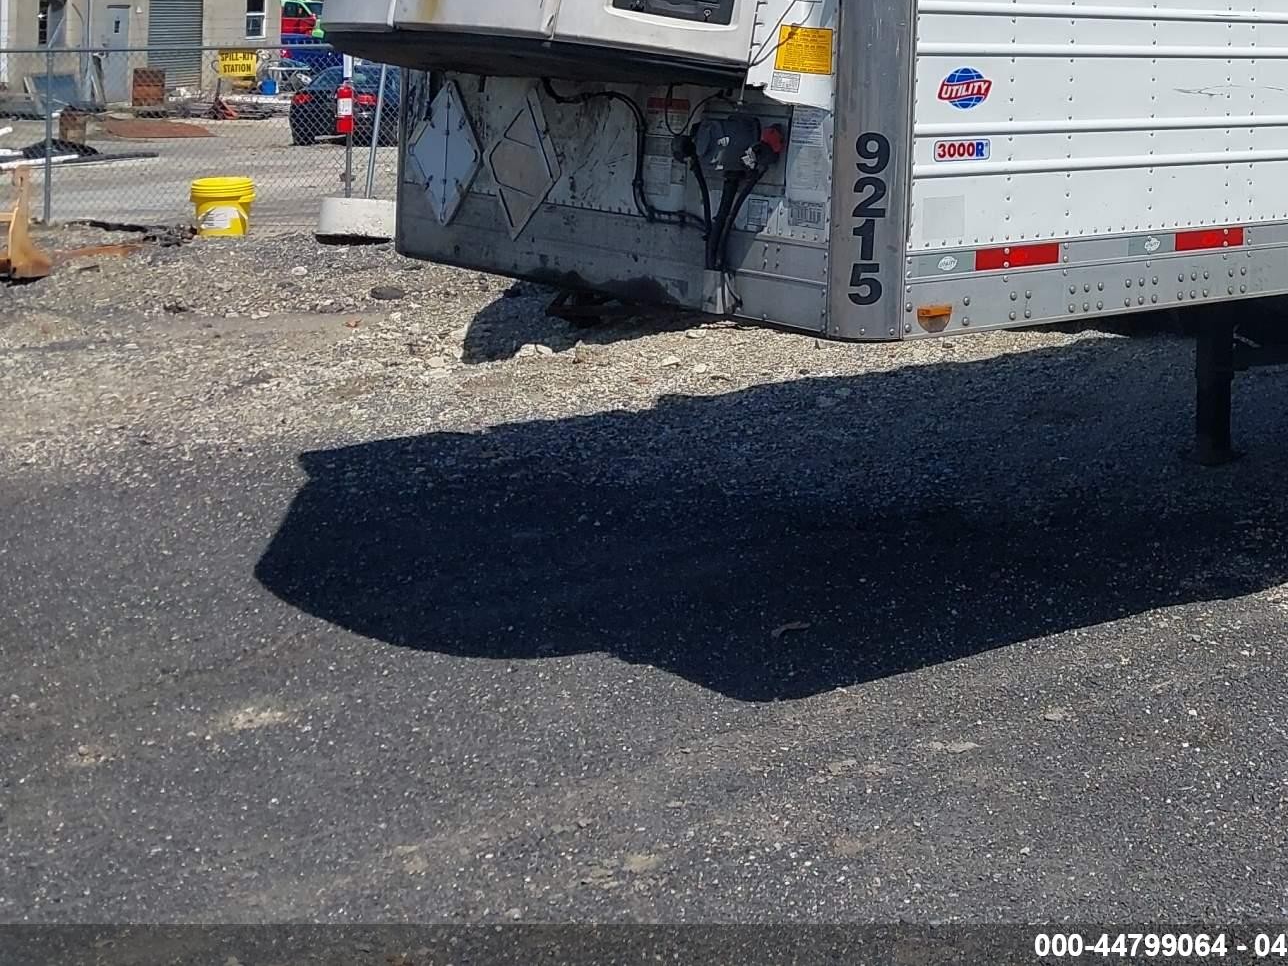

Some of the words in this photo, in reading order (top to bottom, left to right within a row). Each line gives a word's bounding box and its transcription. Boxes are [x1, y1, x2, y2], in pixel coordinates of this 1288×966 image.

[220, 52, 255, 62] SPILL-KIT
[223, 63, 252, 74] STATION
[941, 81, 989, 99] UTILITY
[937, 141, 985, 159] 3000R
[848, 132, 891, 306] 9215
